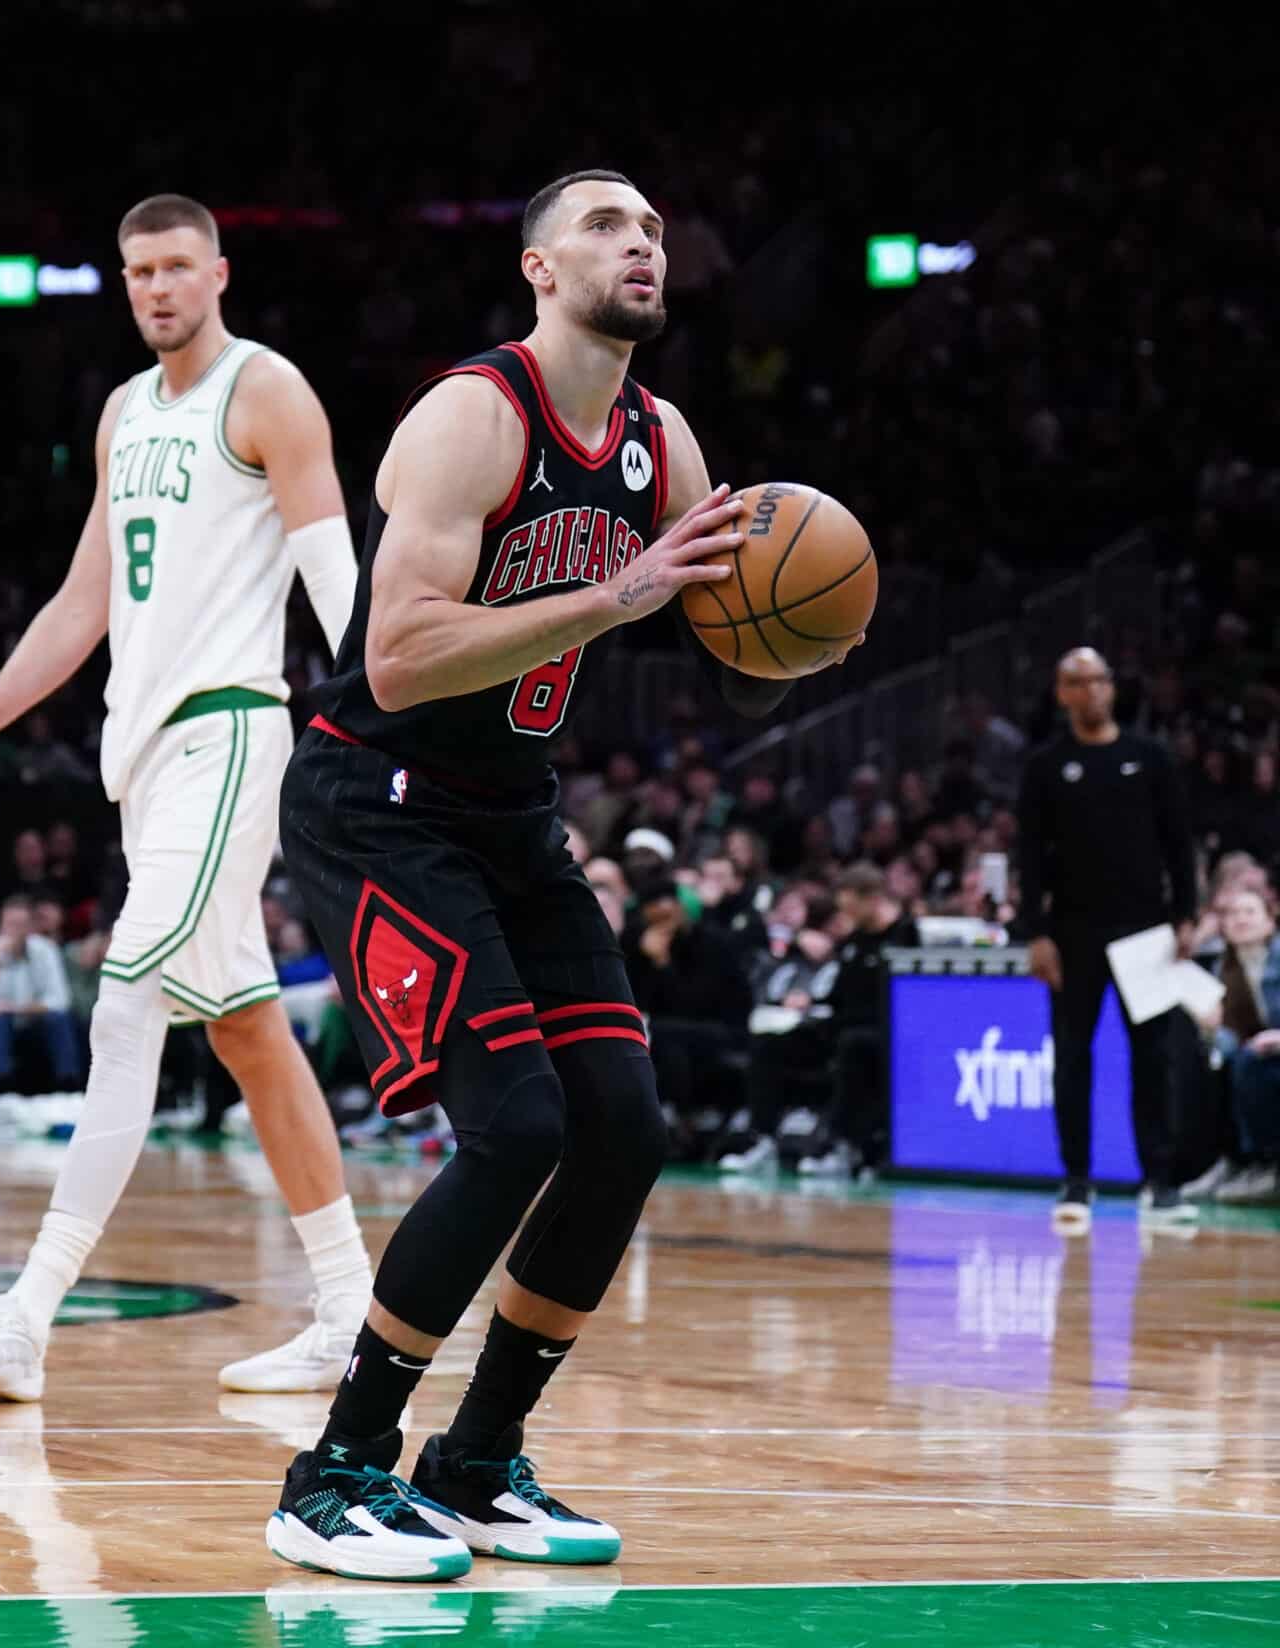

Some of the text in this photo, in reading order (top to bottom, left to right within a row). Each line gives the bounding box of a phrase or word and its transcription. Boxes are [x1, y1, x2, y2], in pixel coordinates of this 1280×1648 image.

[110, 437, 197, 504] ELTICS
[124, 516, 157, 602] 8
[507, 642, 585, 737] 8
